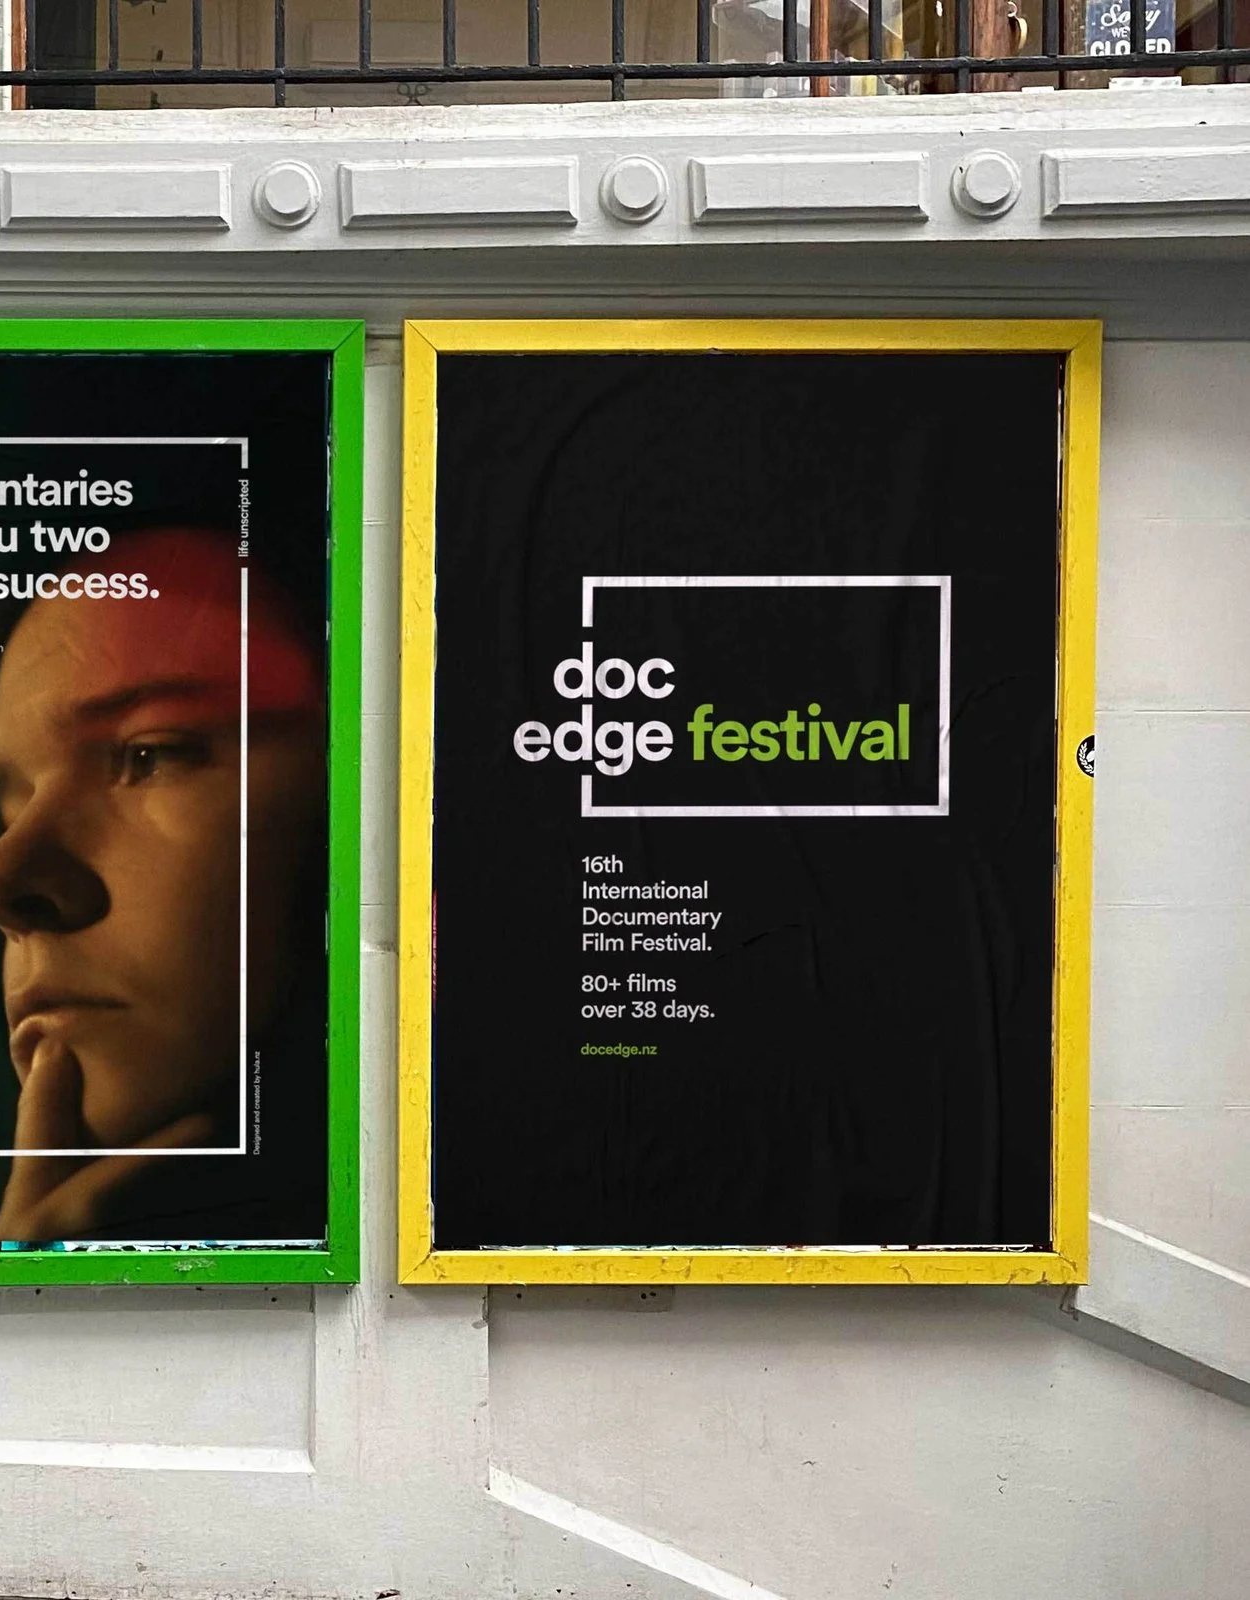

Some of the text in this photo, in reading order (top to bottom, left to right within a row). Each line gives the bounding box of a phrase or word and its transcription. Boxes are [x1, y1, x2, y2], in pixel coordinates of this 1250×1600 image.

[1101, 4, 1161, 31] Soy
[1091, 38, 1171, 56] CLOED
[238, 480, 251, 557] life unscripted
[30, 521, 110, 552] two
[554, 642, 675, 699] doc
[514, 703, 909, 776] edge festival
[582, 854, 623, 873] 16th
[583, 880, 707, 899] International
[583, 907, 722, 929] Documentary
[583, 932, 712, 951] Film Festival.
[582, 974, 676, 992] 80+ films
[582, 1000, 714, 1022] over 38 days.
[581, 1043, 657, 1058] docedge.nz
[254, 1075, 261, 1084] by
[253, 1124, 261, 1155] Designed
